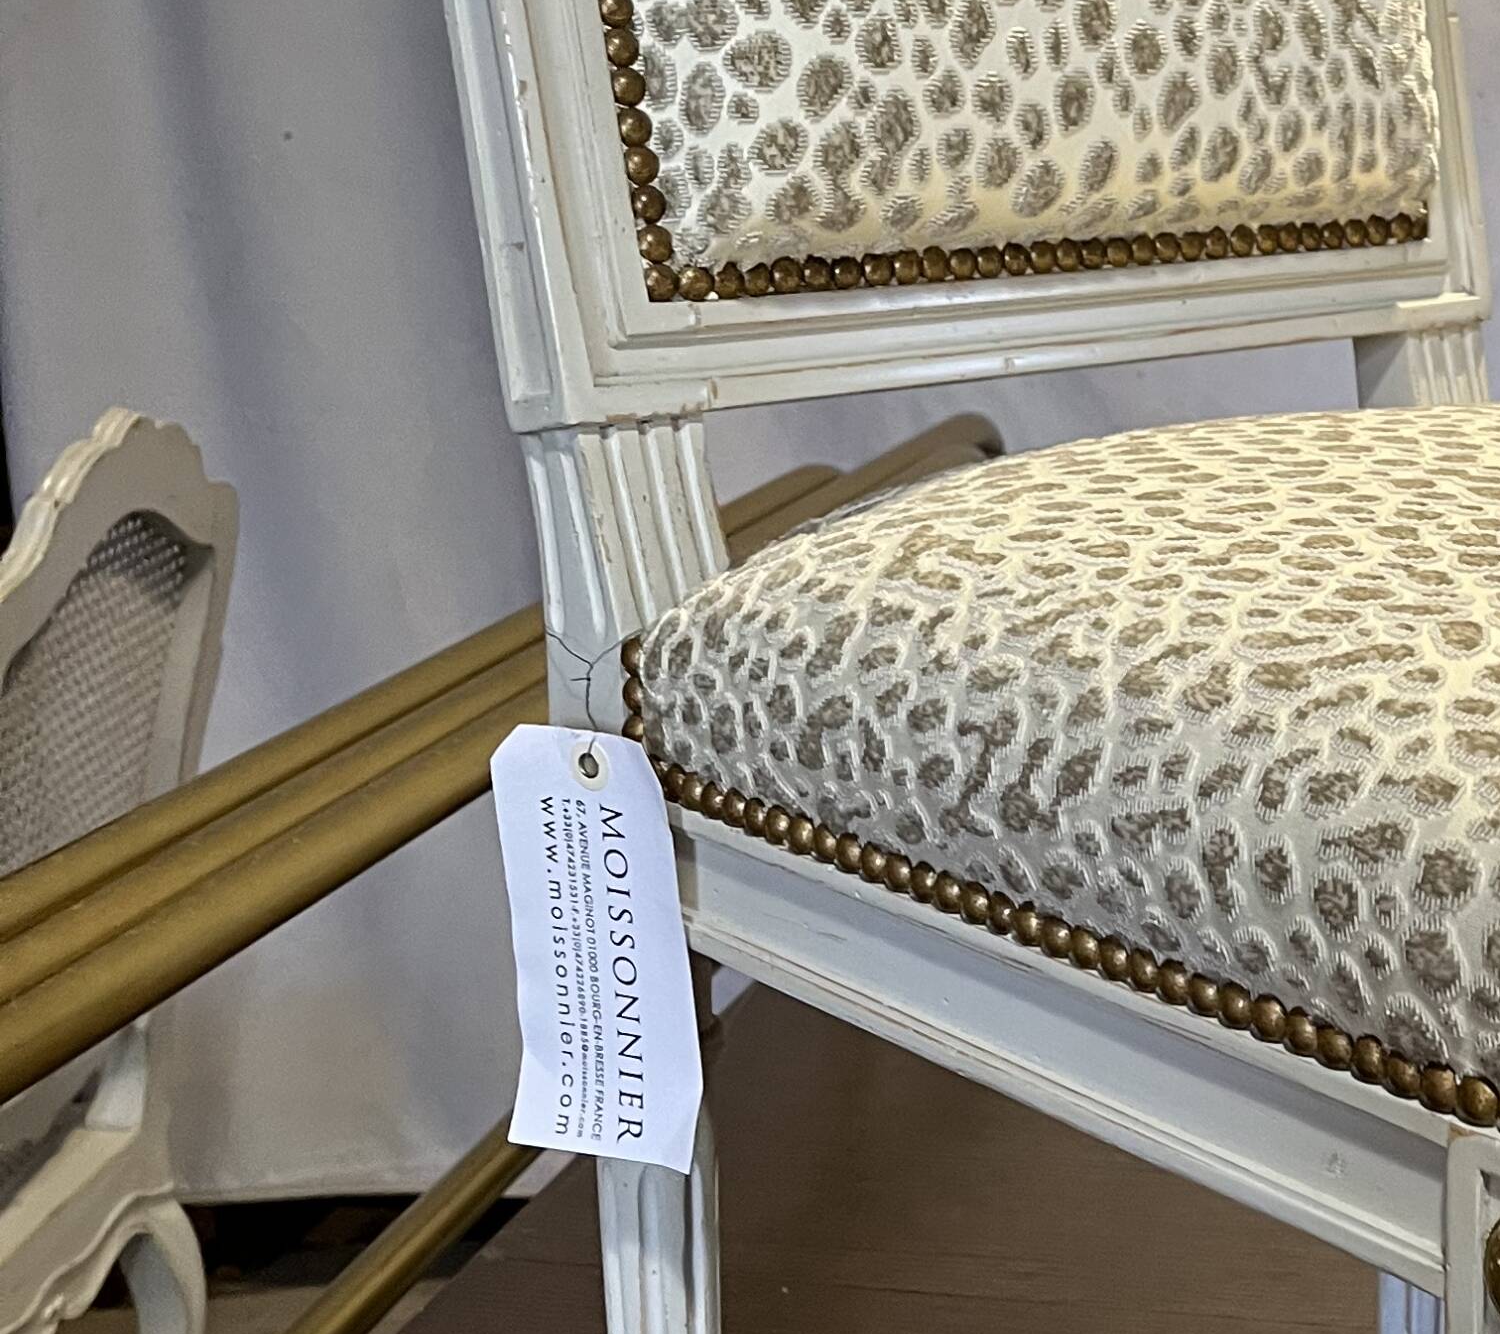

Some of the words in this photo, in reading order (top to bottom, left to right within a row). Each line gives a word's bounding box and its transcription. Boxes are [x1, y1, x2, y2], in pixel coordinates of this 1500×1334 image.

[575, 799, 586, 818] 67,
[577, 821, 591, 872] AVENUE
[582, 873, 596, 934] MAGINOT
[540, 796, 575, 1135] www.moissonnier.com
[586, 936, 599, 973] 01000
[598, 803, 644, 1144] MOISSONNIER
[589, 976, 604, 1087] BOURG-EN-BRESSE
[591, 1089, 604, 1142] FRANCE
